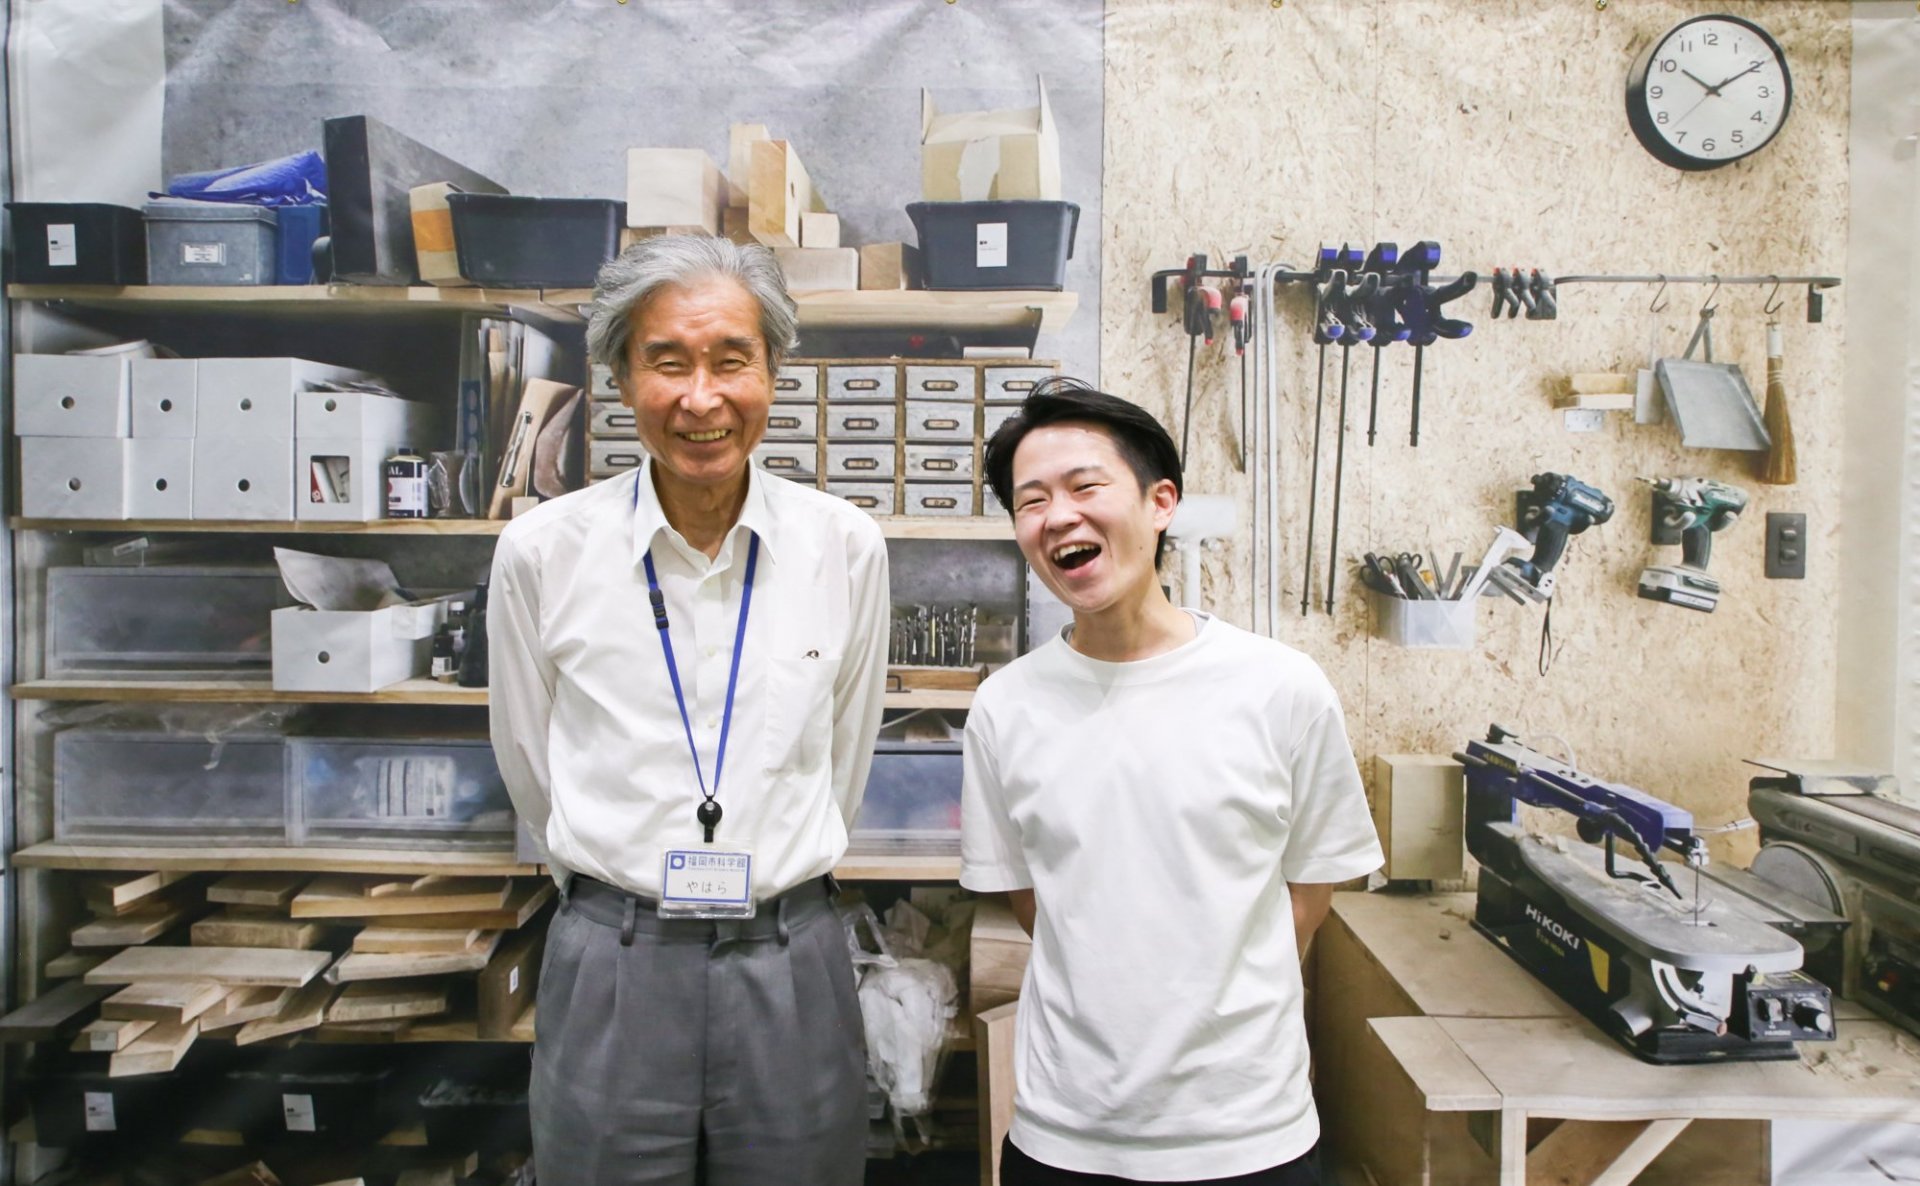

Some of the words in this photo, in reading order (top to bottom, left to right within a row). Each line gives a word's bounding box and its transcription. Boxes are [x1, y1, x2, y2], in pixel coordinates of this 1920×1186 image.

[1703, 33, 1718, 46] 12
[1681, 40, 1693, 53] 11
[1733, 42, 1738, 54] 1
[1660, 59, 1677, 73] 10
[1749, 60, 1761, 73] 2
[1650, 86, 1663, 99] 9
[1757, 86, 1769, 99] 3
[1656, 111, 1669, 124] 8
[1750, 110, 1762, 122] 4
[1675, 131, 1687, 144] 7
[1731, 130, 1743, 143] 5
[1702, 138, 1715, 151] 6
[688, 855, 746, 868] 福岡市科学館
[686, 881, 727, 894] やはら
[1525, 904, 1580, 950] HiKOKI
